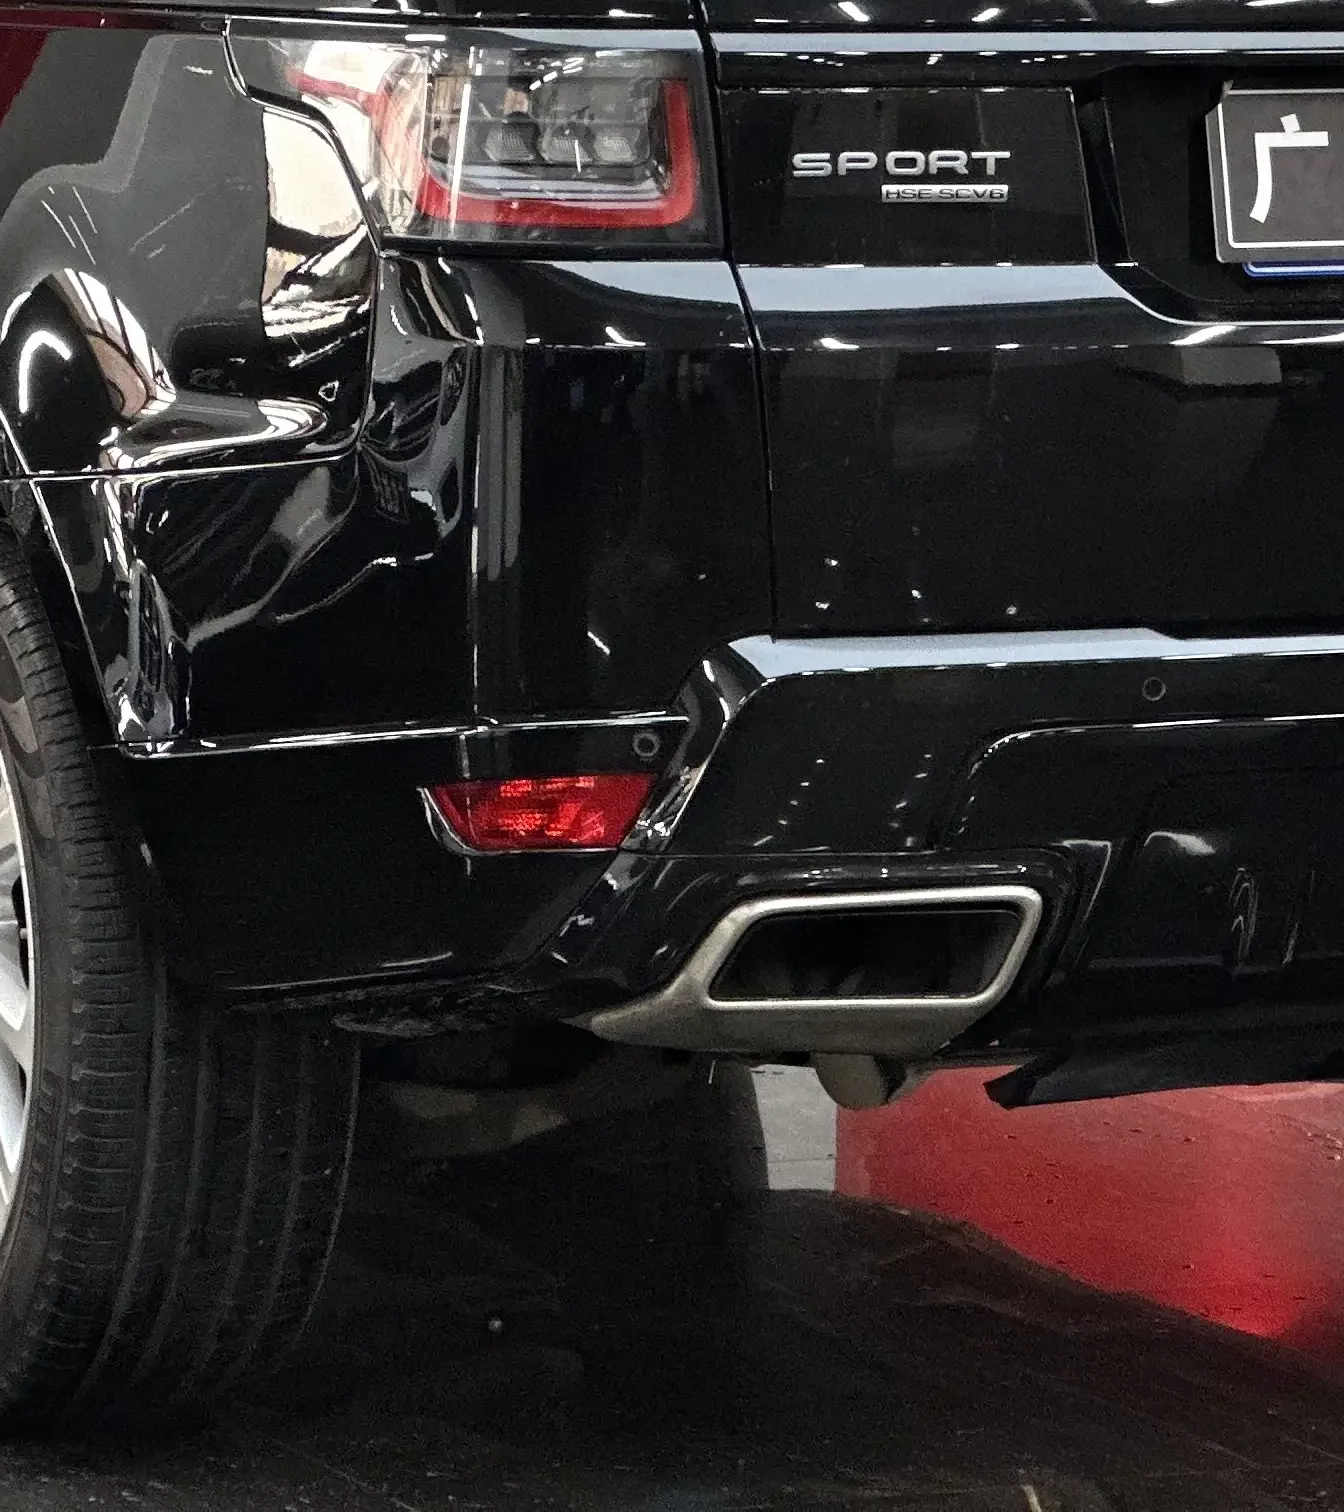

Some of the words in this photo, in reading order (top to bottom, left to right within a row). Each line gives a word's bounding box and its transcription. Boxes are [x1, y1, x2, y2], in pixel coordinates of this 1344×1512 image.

[792, 149, 1011, 177] SPORT
[885, 188, 933, 200] HSE
[938, 188, 1005, 200] SCV6
